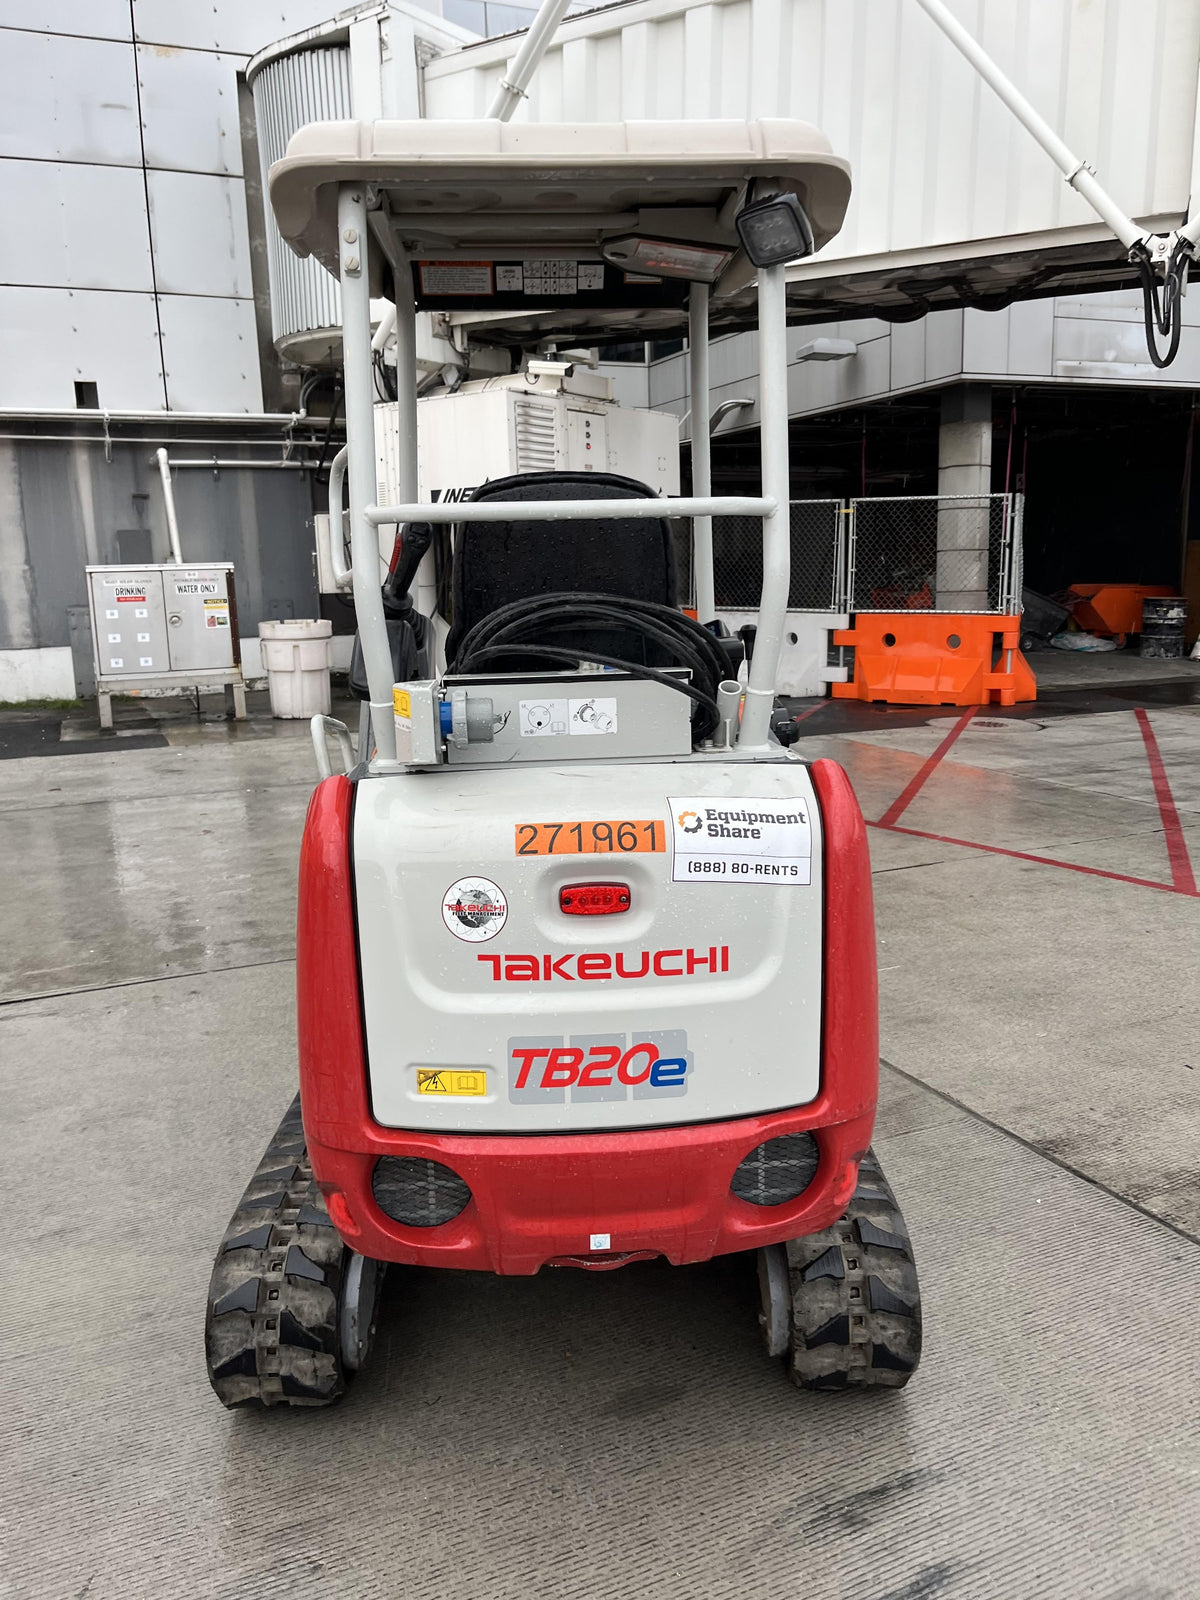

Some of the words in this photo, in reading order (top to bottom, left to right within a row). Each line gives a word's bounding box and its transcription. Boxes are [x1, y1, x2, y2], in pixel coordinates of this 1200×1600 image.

[443, 487, 480, 503] INE
[115, 587, 146, 596] DRINKING
[177, 585, 199, 594] WATER
[200, 584, 216, 593] ONLY
[704, 808, 807, 825] Equipment
[518, 821, 656, 854] 271961
[707, 823, 761, 839] Share
[688, 861, 726, 874] (888)
[731, 863, 799, 877] 80-RENTS
[511, 1043, 688, 1089] TB20e
